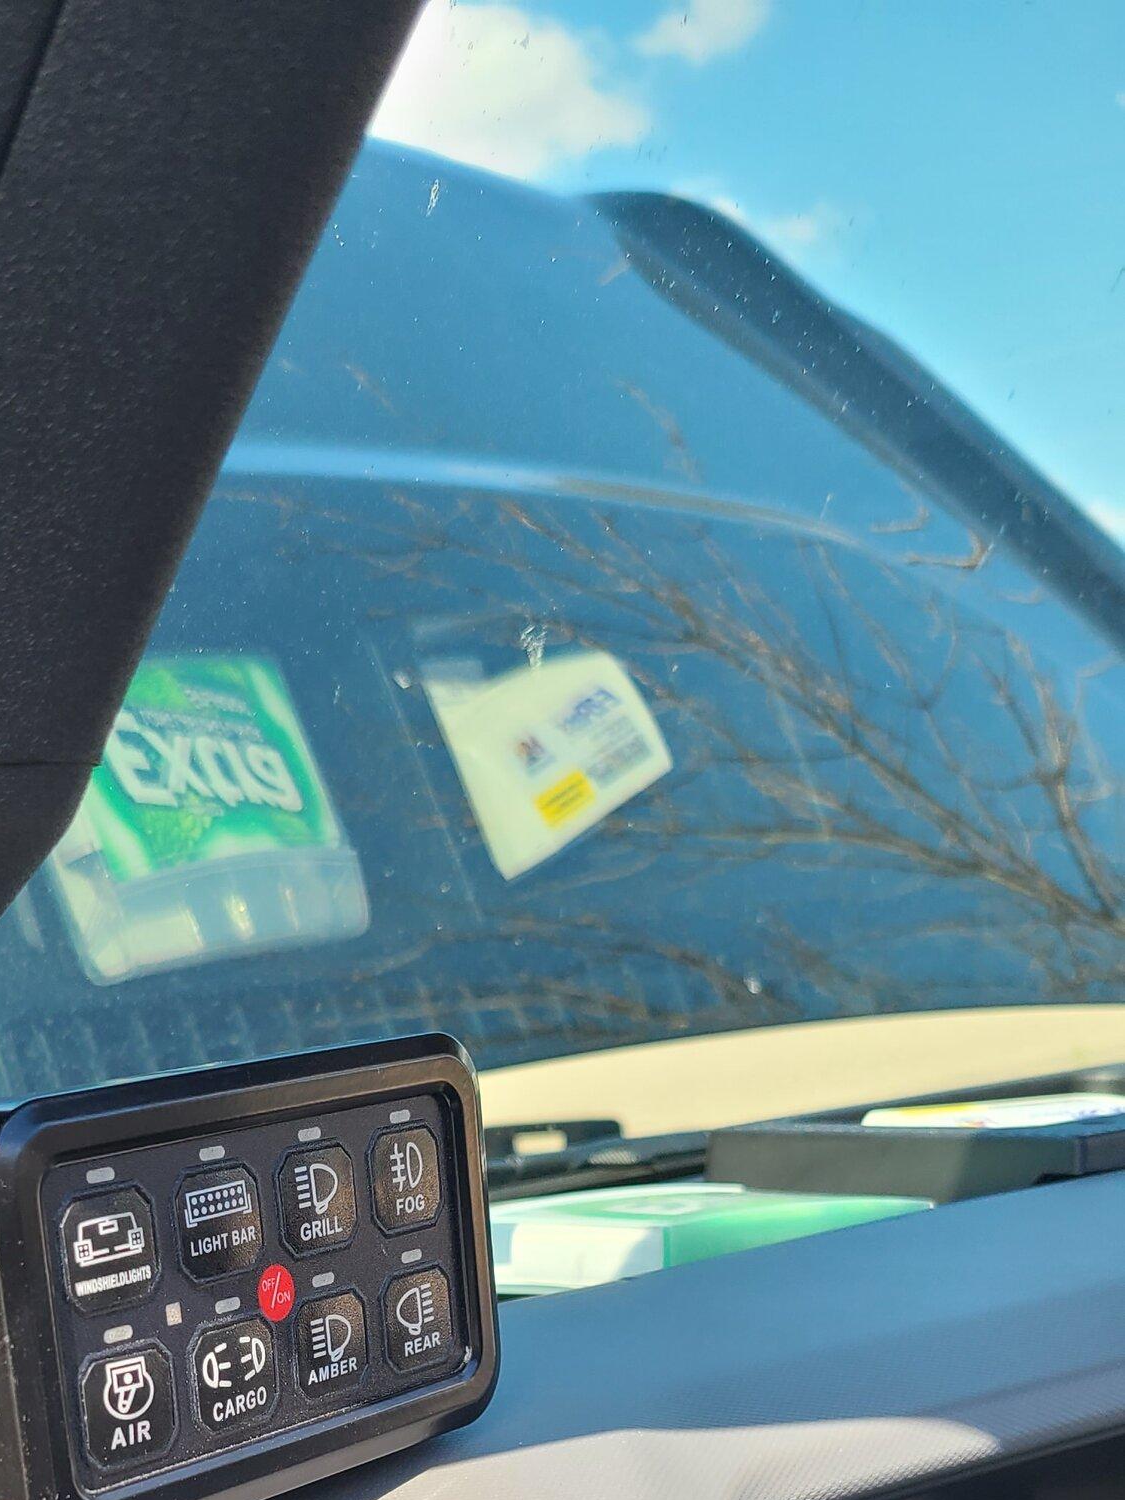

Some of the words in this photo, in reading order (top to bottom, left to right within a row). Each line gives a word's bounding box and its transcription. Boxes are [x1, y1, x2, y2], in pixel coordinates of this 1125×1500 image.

[396, 1193, 426, 1216] FOG
[190, 1232, 229, 1257] LIGHT
[231, 1224, 257, 1246] BAR
[299, 1216, 344, 1242] GRILL
[404, 1331, 441, 1357] REAR
[307, 1358, 358, 1386] AMBER
[212, 1385, 267, 1422] CARGO
[110, 1420, 152, 1450] AIR
